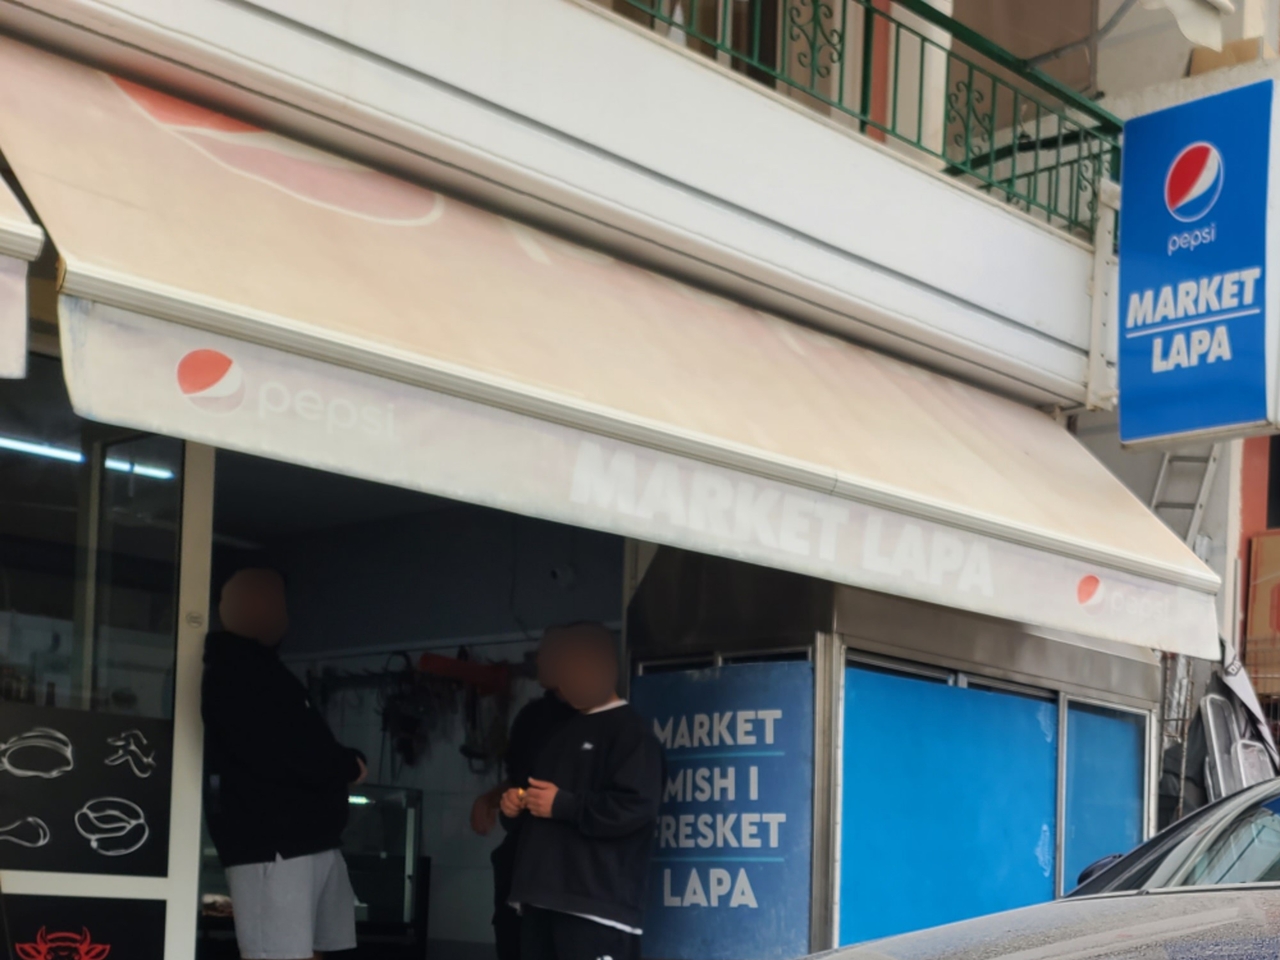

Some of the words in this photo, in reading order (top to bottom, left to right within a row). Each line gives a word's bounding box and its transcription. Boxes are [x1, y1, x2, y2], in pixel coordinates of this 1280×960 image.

[1167, 223, 1217, 256] pepsi
[1125, 267, 1261, 328] MARKET
[1151, 325, 1232, 373] LAPA
[258, 381, 395, 440] pepsi
[571, 439, 849, 562] MARKET
[861, 515, 995, 598] LAPA
[653, 709, 783, 750] MARKET
[664, 766, 736, 803] MISH
[749, 765, 759, 801] I
[655, 812, 787, 849] RESKET
[663, 866, 759, 909] LAPA
